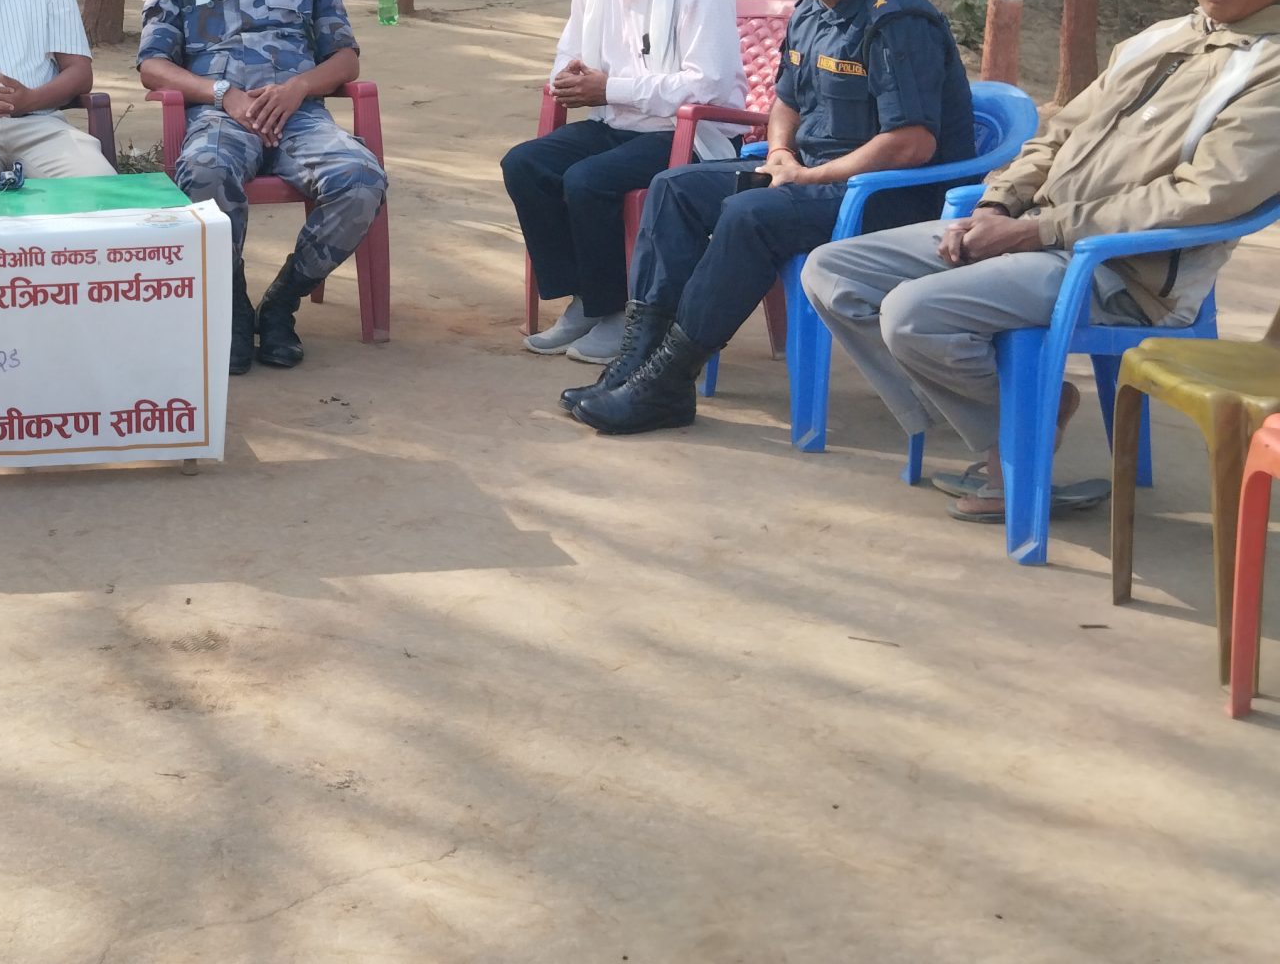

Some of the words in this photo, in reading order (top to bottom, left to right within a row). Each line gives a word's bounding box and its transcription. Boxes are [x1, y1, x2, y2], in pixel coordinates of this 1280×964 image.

[107, 245, 184, 266] कञ्चनपुर
[88, 272, 195, 304] कार्यक्रम
[111, 397, 196, 436] समिति
